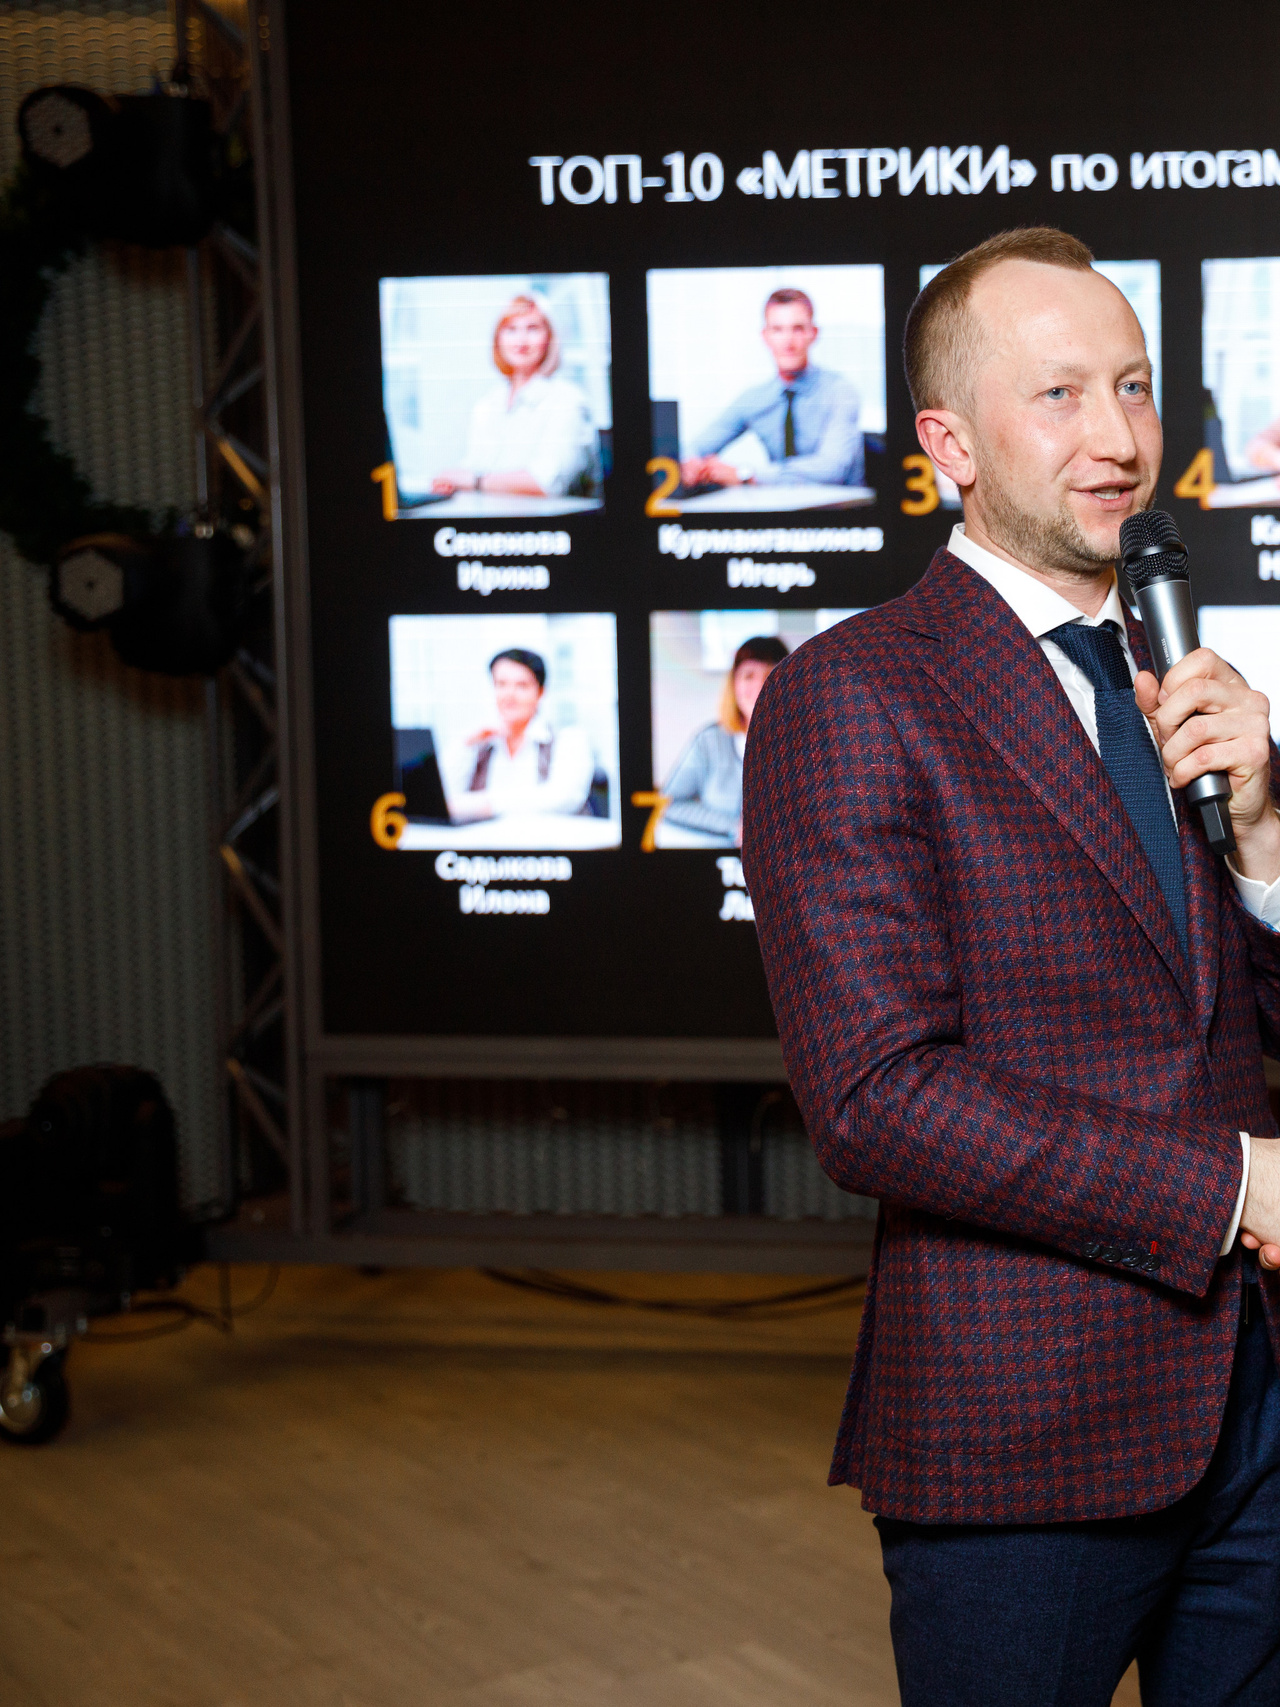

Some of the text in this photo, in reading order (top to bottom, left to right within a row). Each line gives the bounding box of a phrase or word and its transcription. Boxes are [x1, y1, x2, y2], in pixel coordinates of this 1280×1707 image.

[530, 151, 725, 206] ТОП-10
[736, 144, 1037, 200] «МЕТРИКИ»
[1050, 153, 1119, 193] по
[371, 462, 398, 522] 1
[645, 457, 683, 518] 2
[901, 453, 940, 516] 3
[1173, 447, 1216, 510] 4
[457, 560, 550, 596] Ирина
[726, 557, 816, 593] Игорь
[370, 791, 408, 850] 6
[631, 791, 669, 852] 7
[459, 884, 551, 915] Илона
